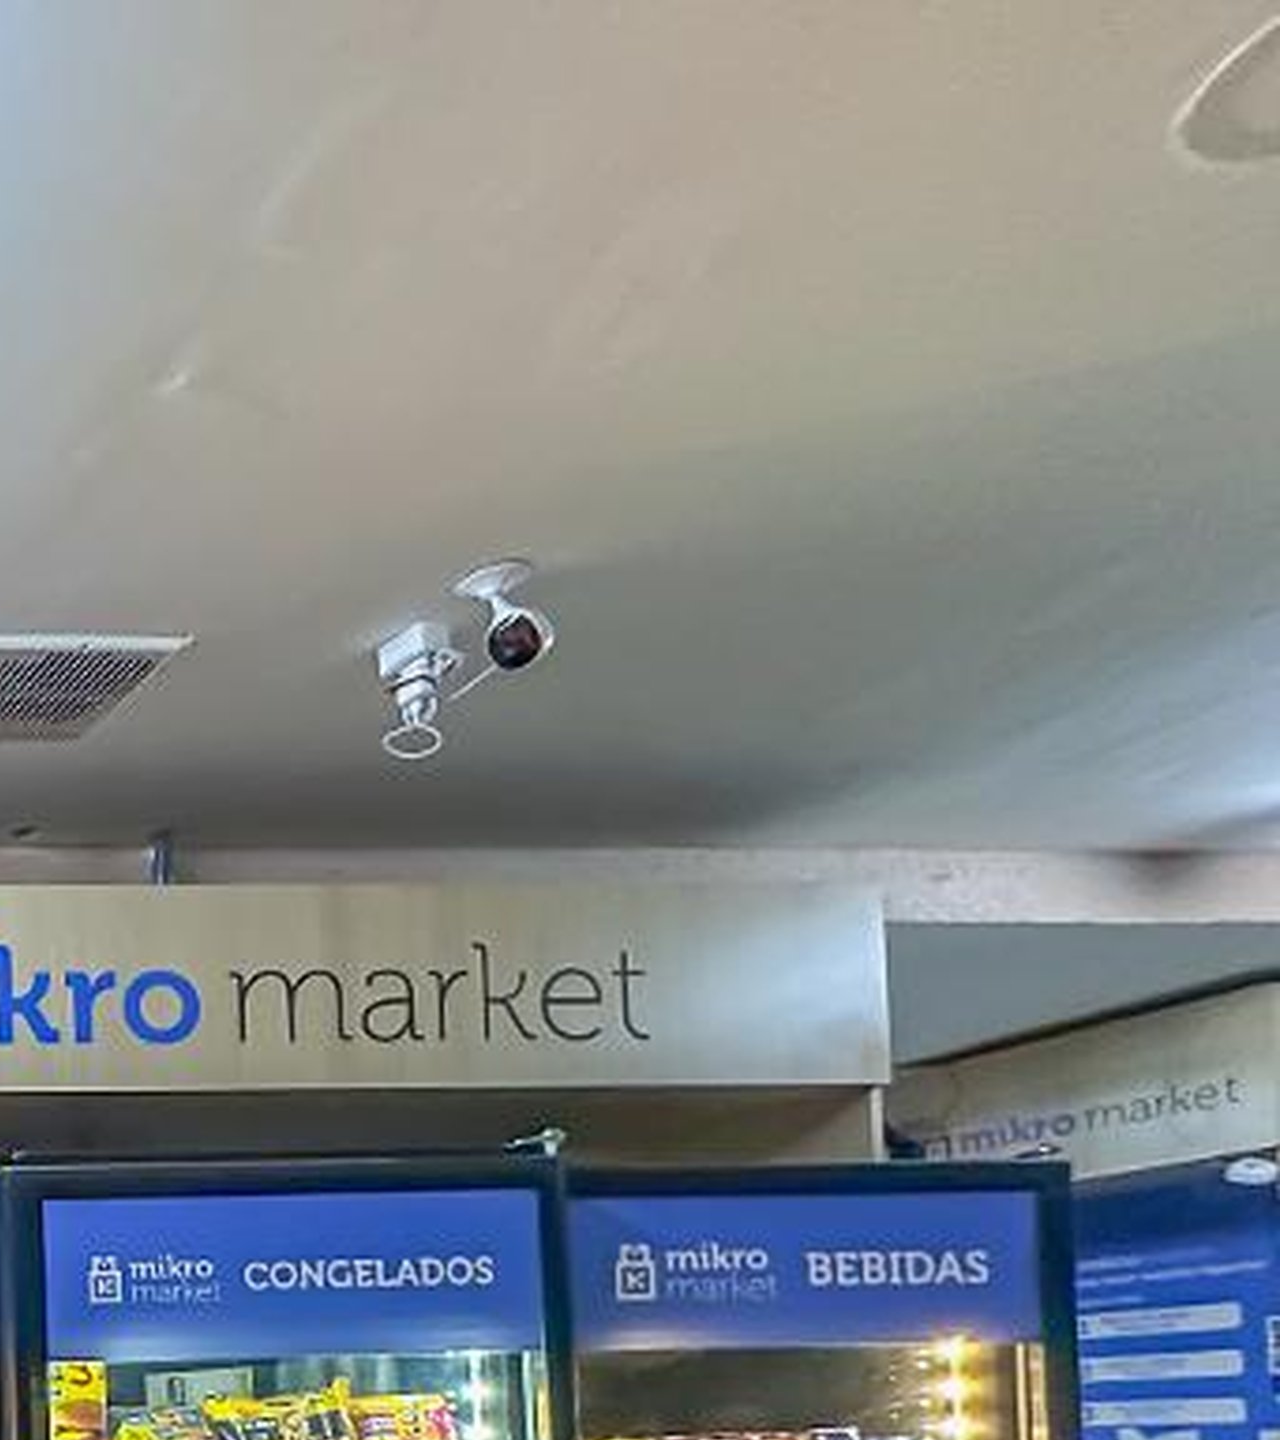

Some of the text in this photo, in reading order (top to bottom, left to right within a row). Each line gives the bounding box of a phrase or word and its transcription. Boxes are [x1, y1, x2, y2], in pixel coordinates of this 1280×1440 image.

[229, 943, 652, 1044] market
[959, 1076, 1240, 1152] mikro market
[128, 1254, 495, 1291] mikro CONGELADOS
[665, 1243, 990, 1287] mikro BEBIDAS
[130, 1281, 221, 1303] market
[666, 1275, 778, 1301] market
